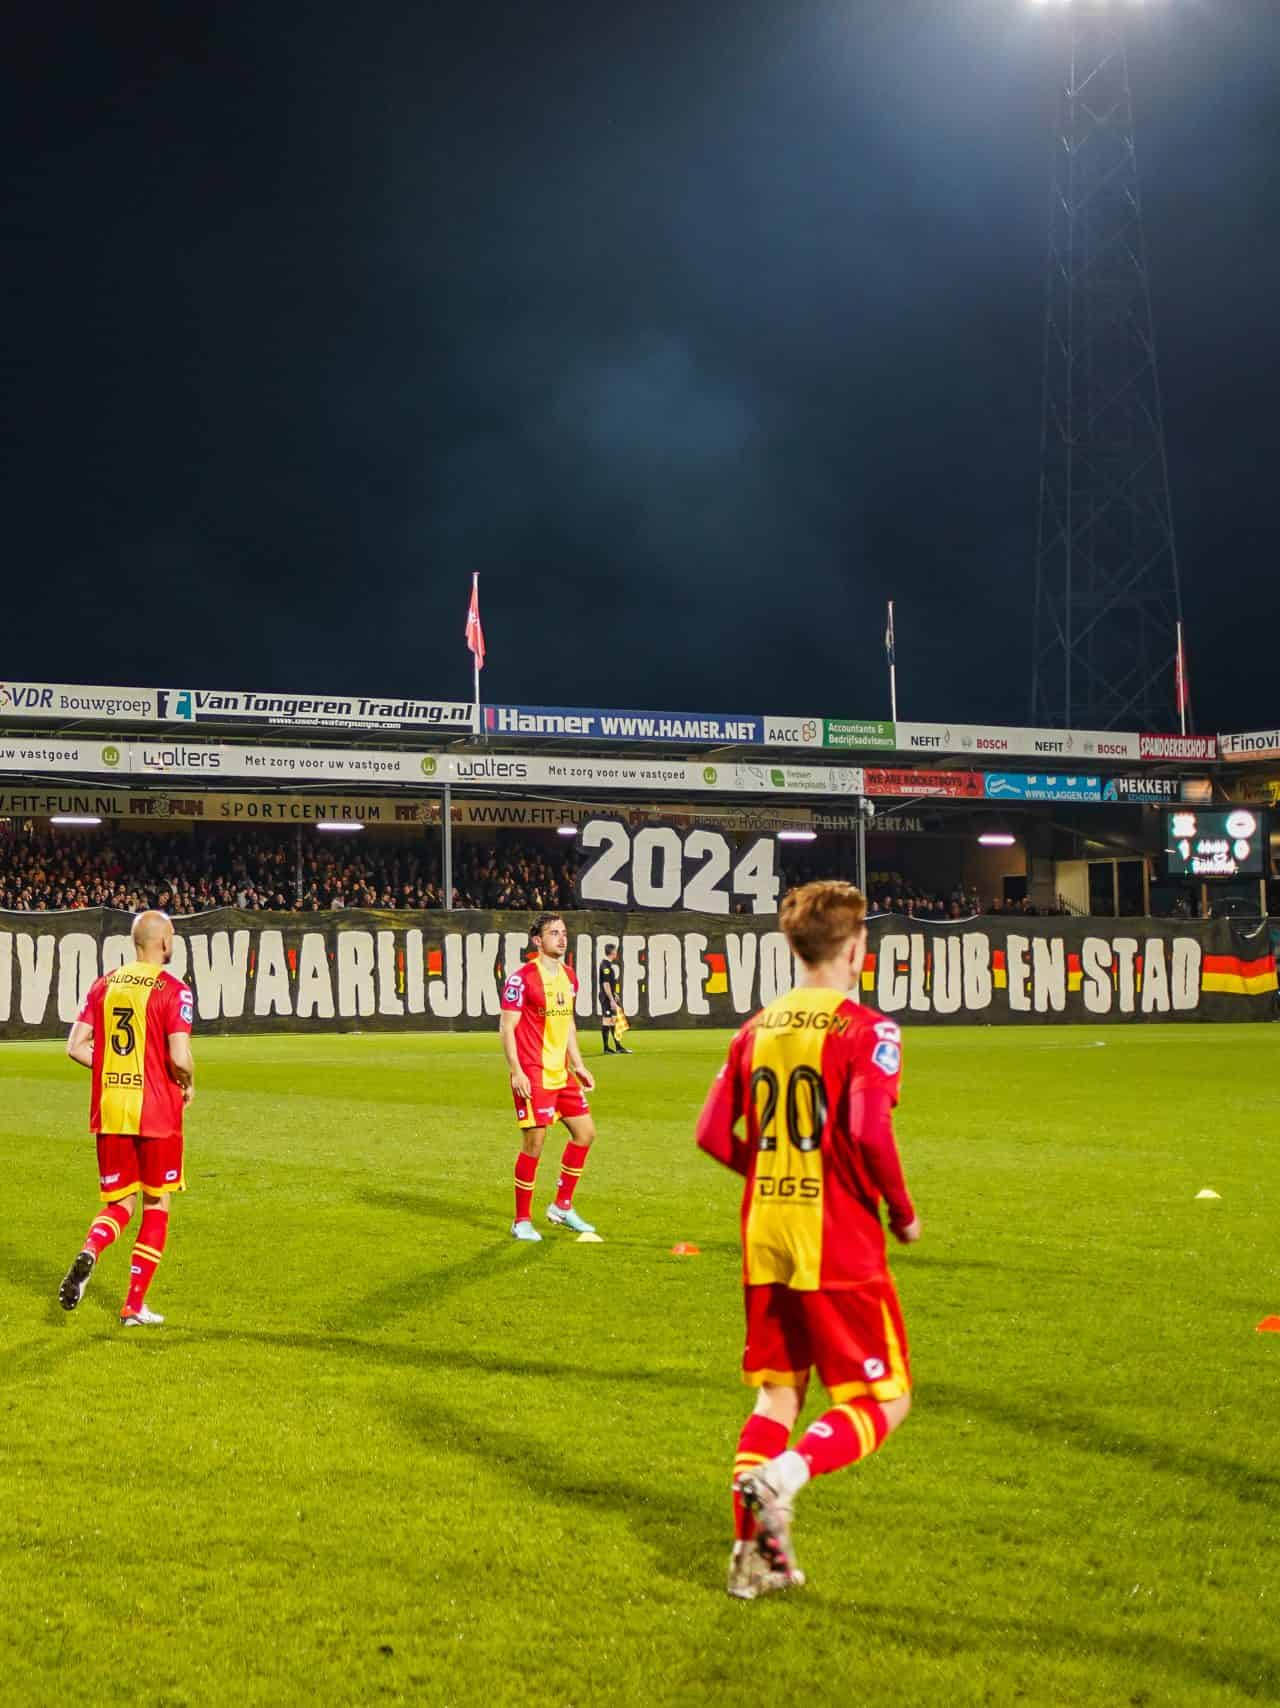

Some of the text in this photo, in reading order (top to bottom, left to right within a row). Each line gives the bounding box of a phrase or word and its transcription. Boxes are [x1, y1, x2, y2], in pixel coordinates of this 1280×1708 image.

[12, 687, 54, 708] VDR
[60, 695, 151, 715] Bouwgroep
[357, 699, 473, 722] Trading.nl
[498, 707, 756, 740] Hamer WWW.HAMER.NET
[828, 723, 875, 734] Accountants
[769, 729, 799, 742] AACC
[911, 736, 940, 747] NEFIT
[976, 739, 1008, 749] BOSCH
[20, 747, 79, 762] vastgoed
[1035, 741, 1063, 752] NEFIT
[1097, 744, 1127, 755] BOSCH
[143, 747, 220, 768] wolters
[245, 755, 400, 772] Met zorg voor uw vastgoed
[457, 758, 527, 777] wolters
[548, 766, 685, 780] Met zorg voor uw vastgoed
[1120, 779, 1178, 794] HEKKERT
[221, 804, 380, 819] SPORTCENTRUM
[581, 820, 780, 914] 2024
[878, 932, 992, 1013] CLUB
[1006, 934, 1067, 1014] EN
[1081, 937, 1202, 1014] STAD
[111, 1007, 135, 1056] 3
[751, 1065, 827, 1152] 20
